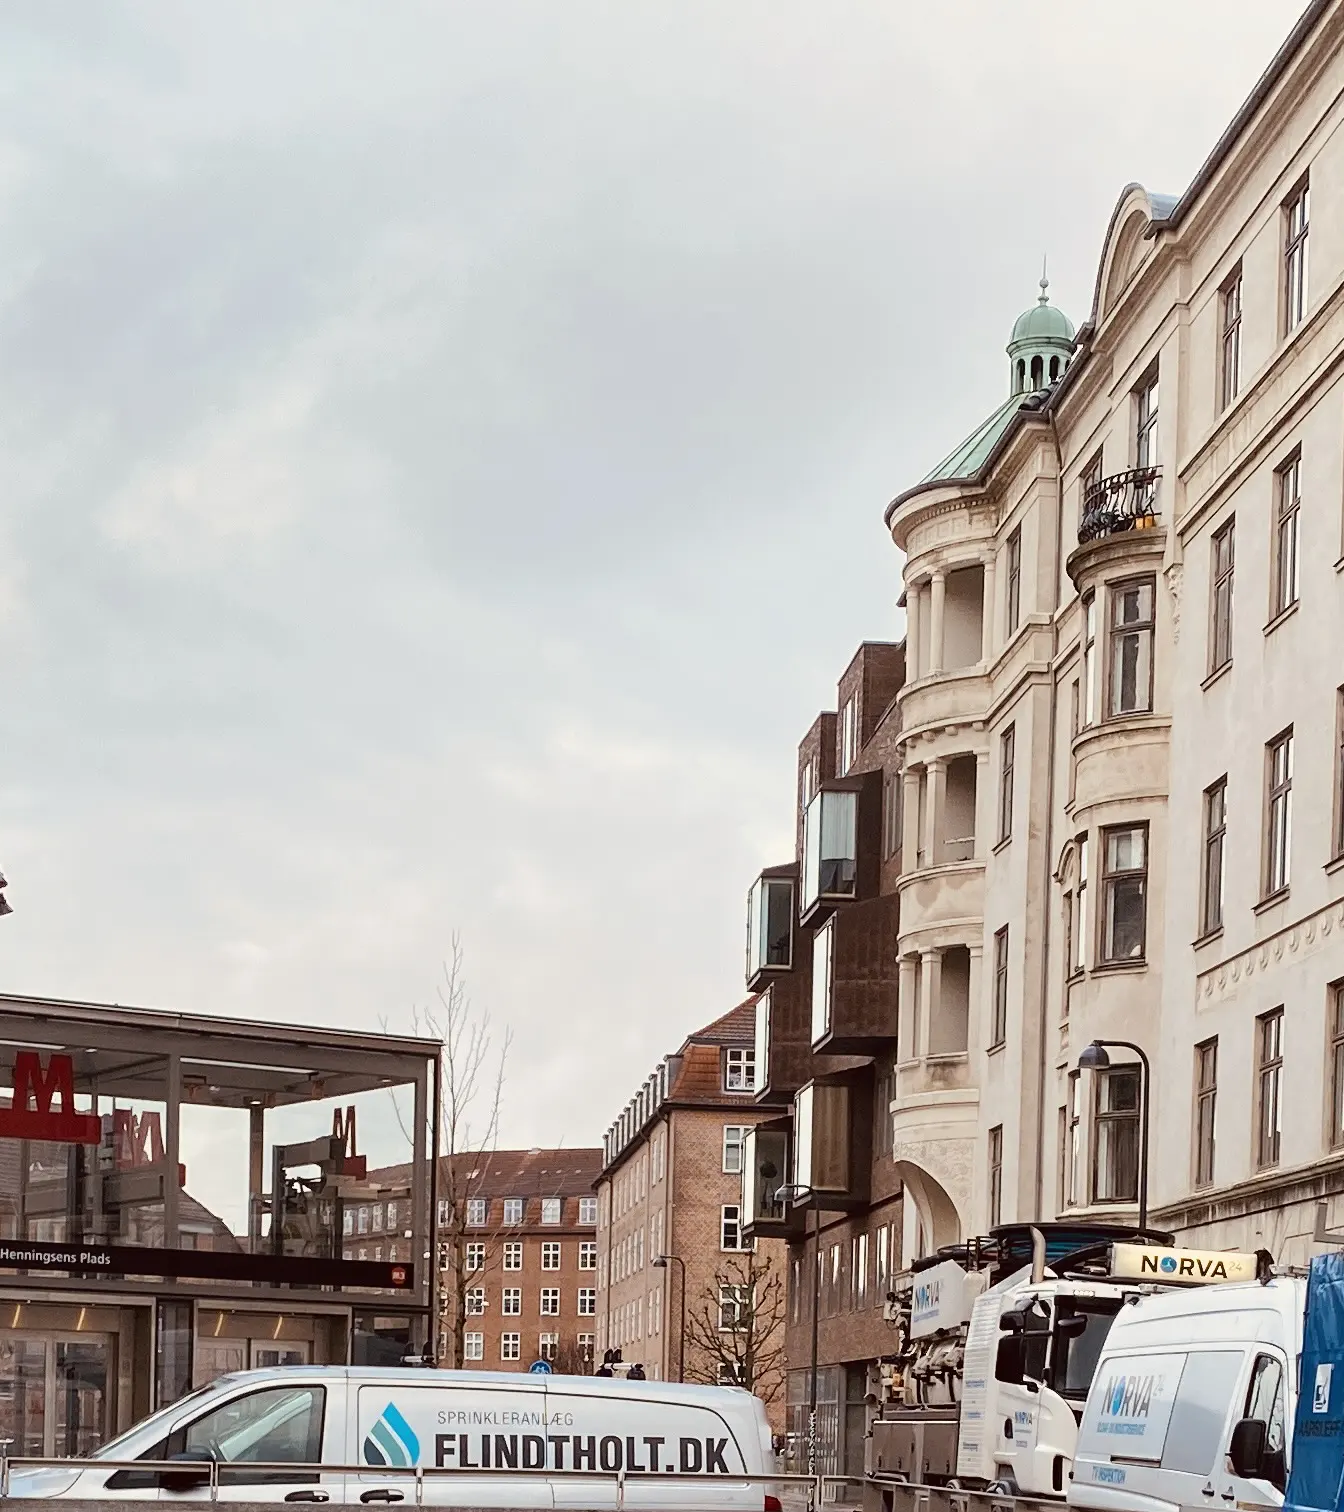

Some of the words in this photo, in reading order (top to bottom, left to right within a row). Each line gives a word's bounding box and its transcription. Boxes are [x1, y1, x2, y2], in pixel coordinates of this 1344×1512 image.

[0, 1247, 77, 1264] Henningsens
[80, 1251, 111, 1265] Plads
[437, 1410, 574, 1427] SPRINKLERANLÆG
[435, 1433, 729, 1474] FLINDTHOLT.DK
